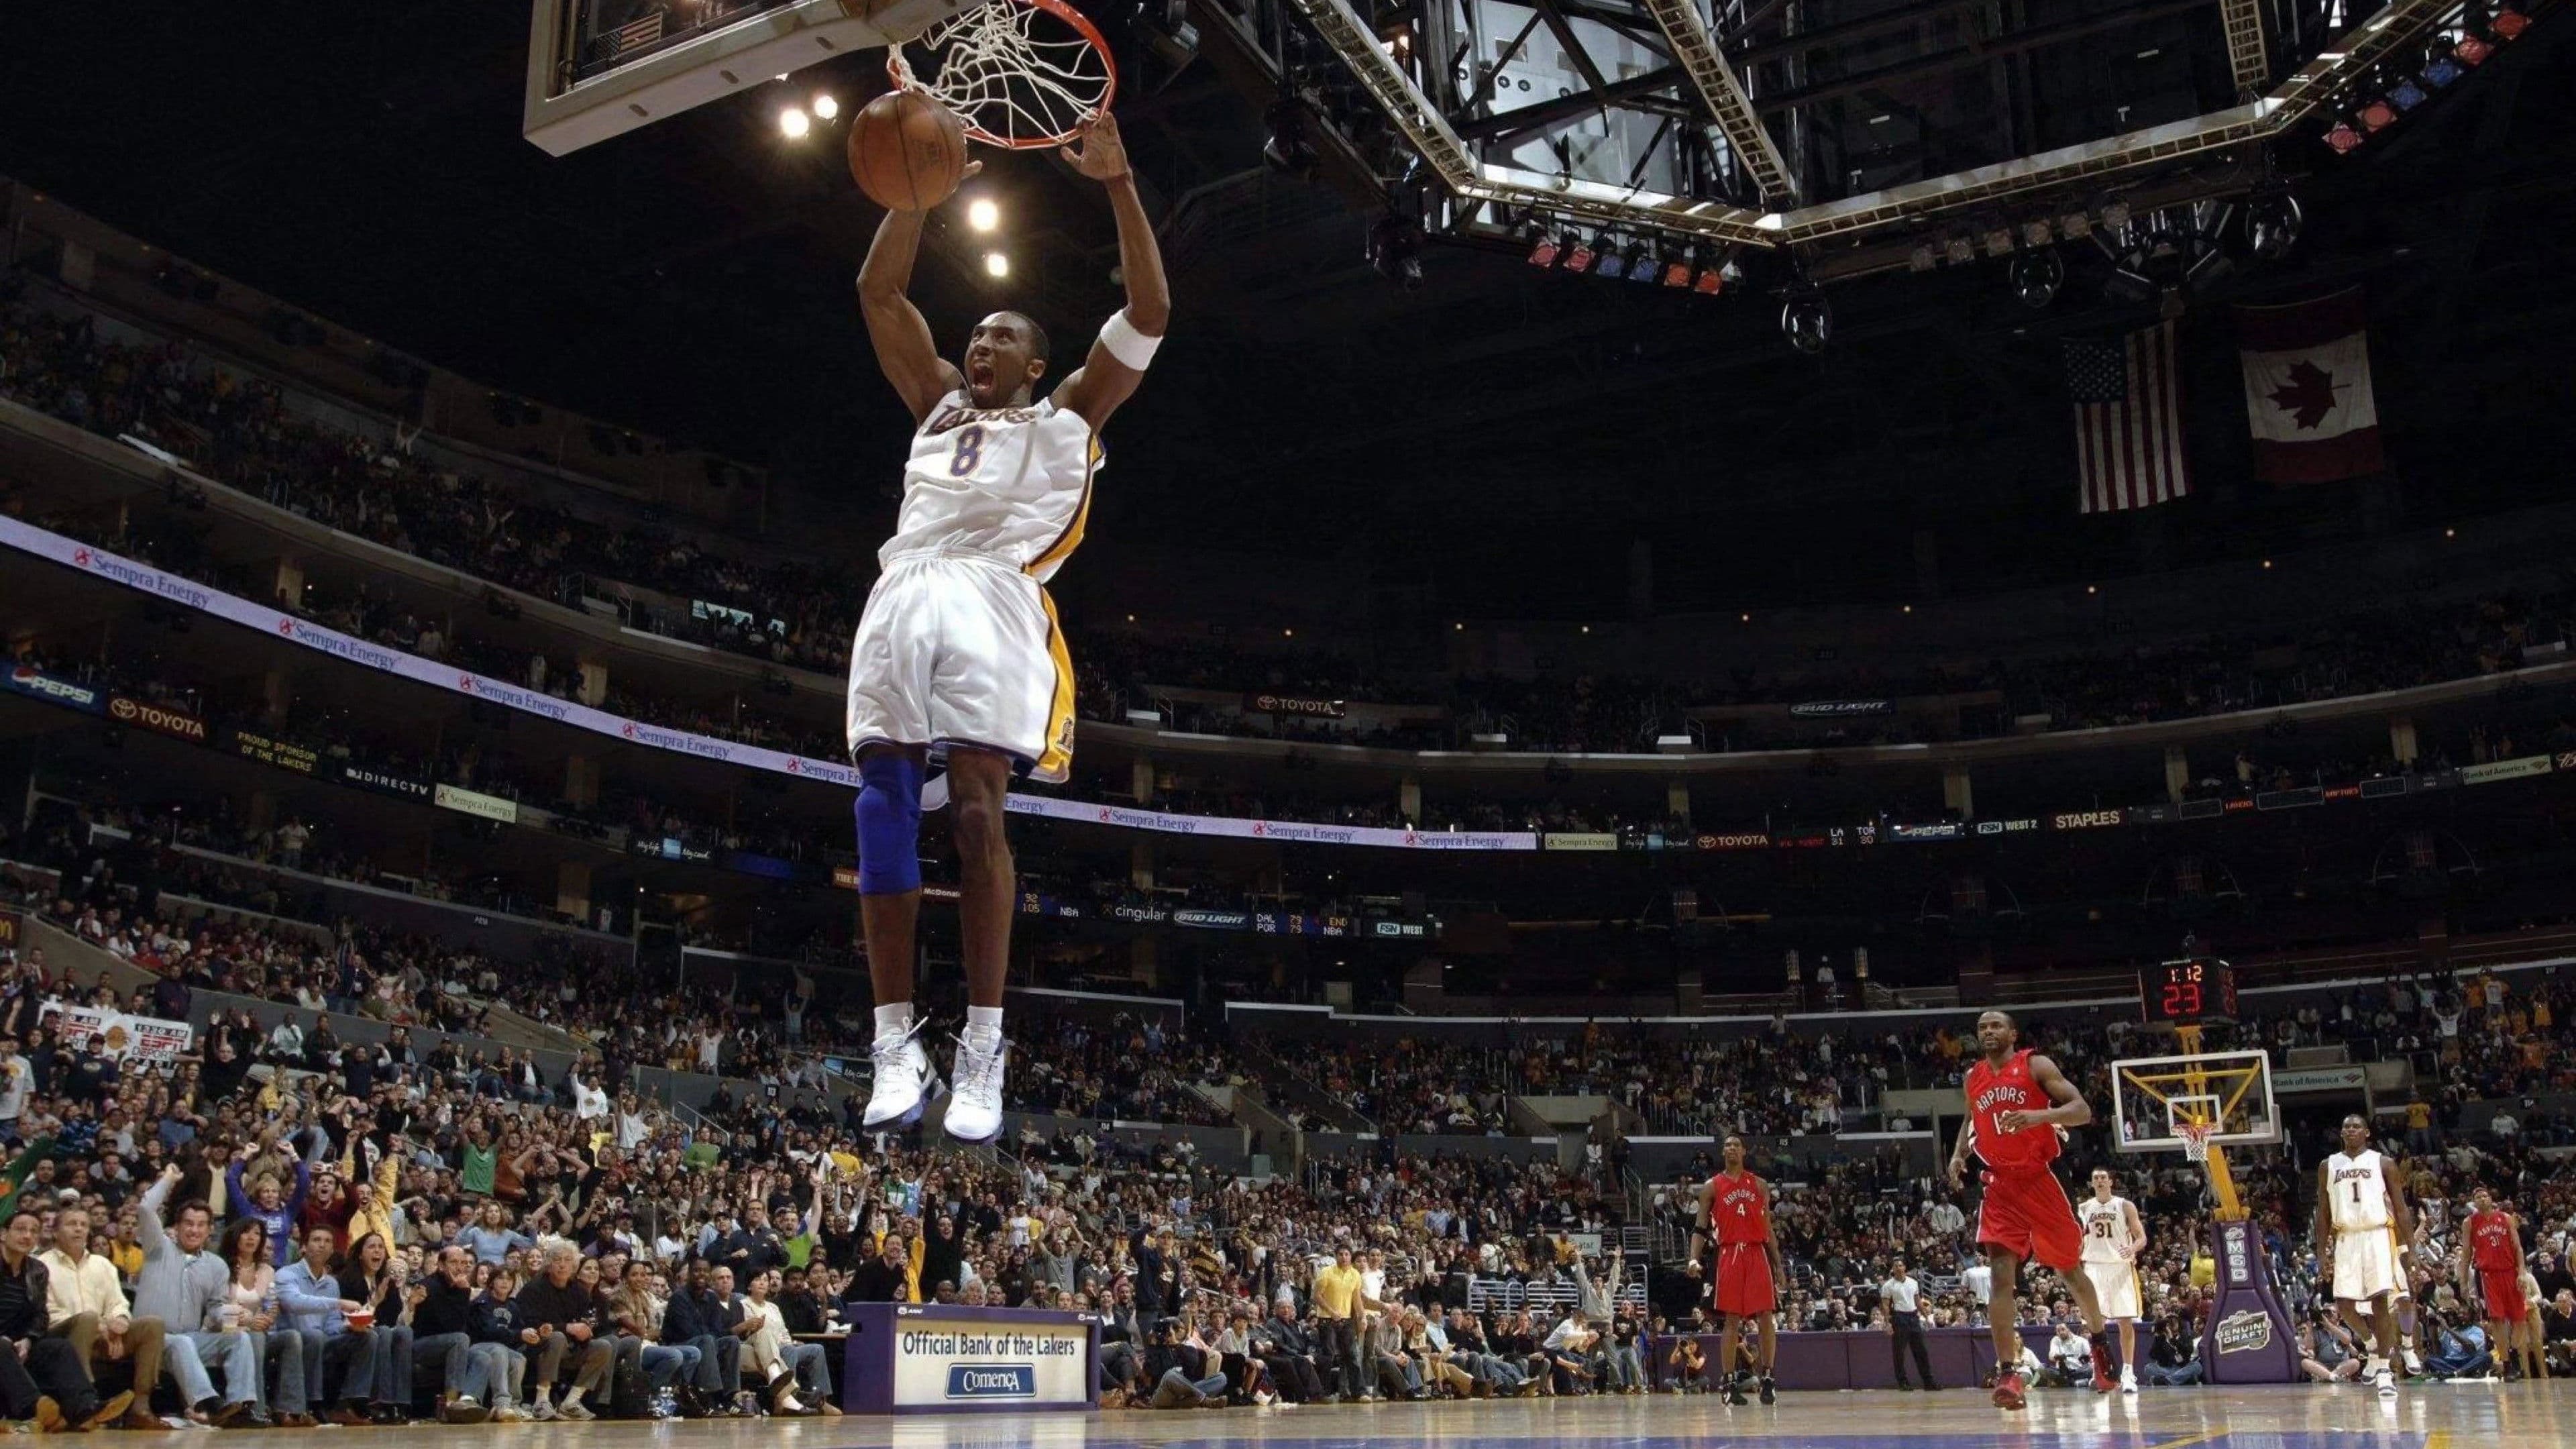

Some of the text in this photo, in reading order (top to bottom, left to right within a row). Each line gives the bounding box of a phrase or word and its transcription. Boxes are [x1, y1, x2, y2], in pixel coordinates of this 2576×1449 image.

[950, 425, 983, 477] 8
[94, 552, 211, 607] Sempra Energy
[295, 624, 397, 669] Sempra Energy
[31, 676, 94, 704] PEPSI
[476, 679, 567, 720] Sempra Energy
[1279, 698, 1332, 712] TOYOTA
[139, 706, 204, 737] TOYOTA
[637, 727, 730, 759] Sempra Energy
[801, 761, 845, 782] Sempra
[364, 772, 429, 795] DIRECTV
[450, 794, 511, 818] Sempra Energy
[1006, 795, 1044, 814] Energy
[1112, 810, 1196, 832] Sempra Energy
[2004, 820, 2029, 830] WEST
[2031, 820, 2037, 828] 2
[2055, 811, 2120, 828] STAPLES
[1267, 823, 1352, 843] Sempra Energy
[1831, 827, 1876, 837] LA TOR
[1913, 825, 1955, 837] PEPSI
[1419, 836, 1505, 848] Sempra Energy
[1717, 835, 1768, 845] TOYOTA
[1060, 907, 1079, 917] NBA
[1115, 905, 1167, 922] cingular
[1180, 914, 1246, 924] BUD LIGHT
[1256, 914, 1275, 924] DAL
[1330, 917, 1348, 926] END
[1257, 924, 1276, 932] POR
[1324, 926, 1342, 936] NBA
[1403, 925, 1423, 934] WEST
[2171, 965, 2202, 982] 1:12
[2163, 983, 2200, 1014] 23
[141, 1034, 185, 1053] ESPN
[2295, 1077, 2304, 1086] of
[2305, 1076, 2339, 1085] America
[1976, 1086, 2027, 1114] RAPTORS
[2333, 1169, 2371, 1184] LAKERS
[1723, 1188, 1756, 1205] RAPTORS
[2352, 1182, 2360, 1203] 1
[1737, 1203, 1746, 1216] 4
[2088, 1213, 2117, 1223] LAKERS
[2095, 1222, 2112, 1238] 31
[2477, 1224, 2507, 1236] RAPTORS
[903, 1330, 1075, 1356] Official Bank of the Lakers
[2224, 1329, 2264, 1344] DRAFT
